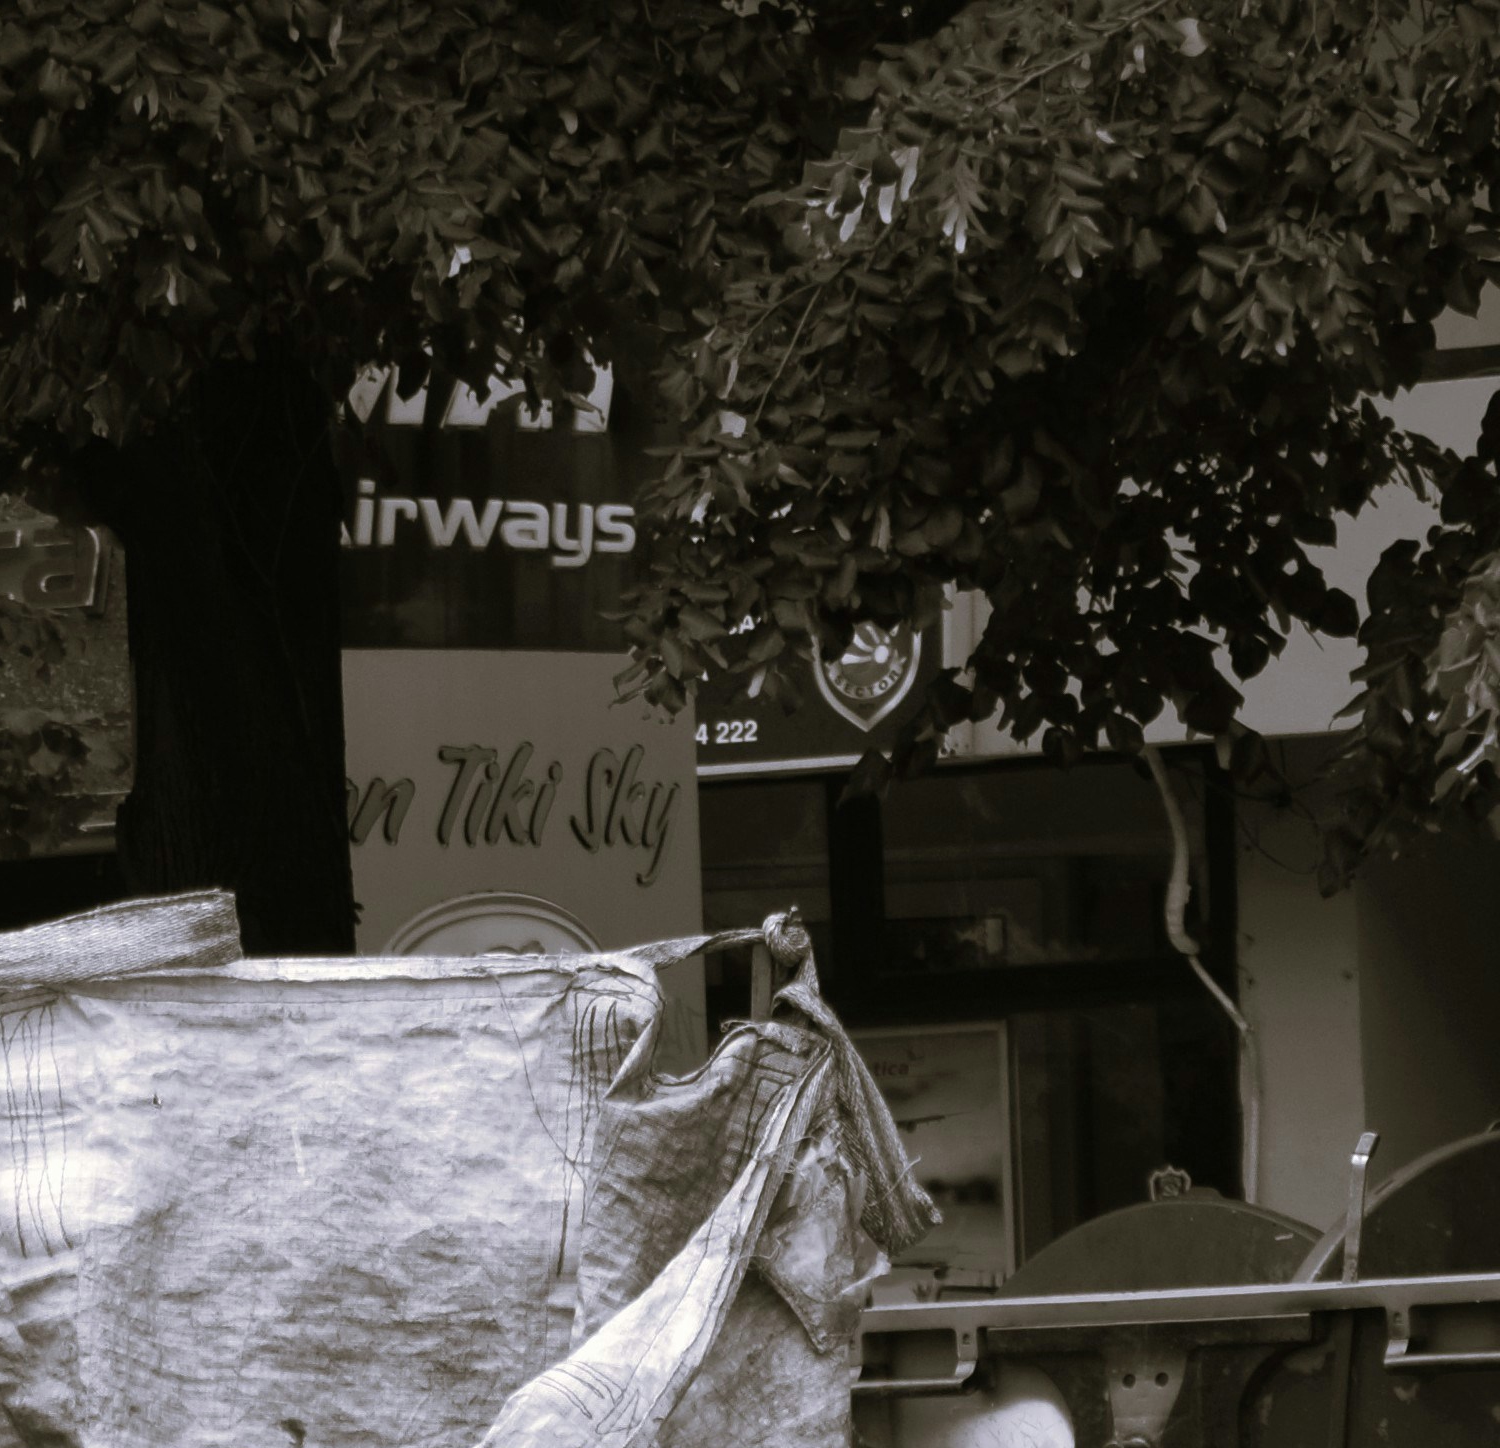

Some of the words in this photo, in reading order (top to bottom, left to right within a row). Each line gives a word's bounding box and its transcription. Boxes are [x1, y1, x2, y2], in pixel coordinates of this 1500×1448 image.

[715, 719, 758, 744] 222
[438, 741, 563, 849] Tiki
[570, 743, 681, 887] Sky
